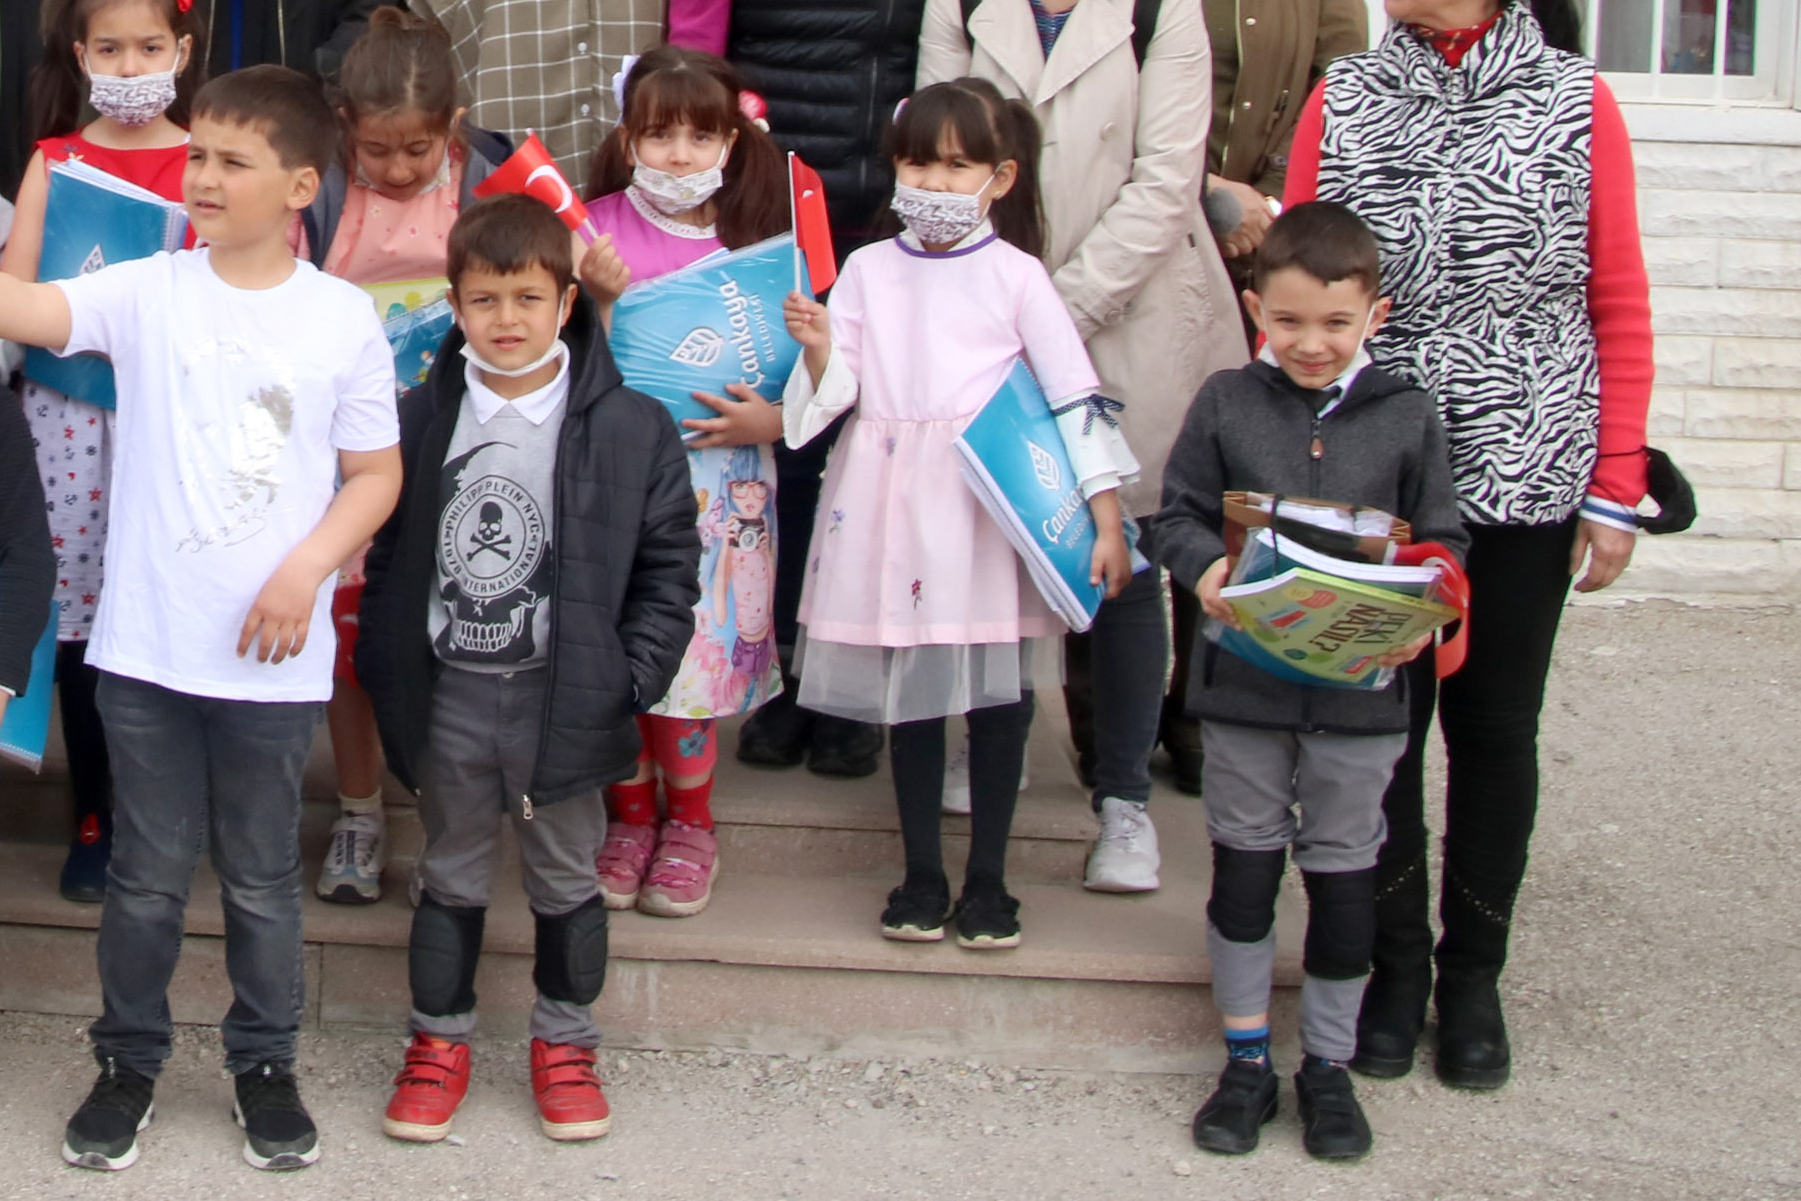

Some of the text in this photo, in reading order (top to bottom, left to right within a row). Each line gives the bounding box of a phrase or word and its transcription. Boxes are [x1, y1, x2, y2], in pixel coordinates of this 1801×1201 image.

[719, 280, 765, 389] Çankaya
[485, 481, 523, 502] PLEIN
[1042, 487, 1084, 544] Çanka
